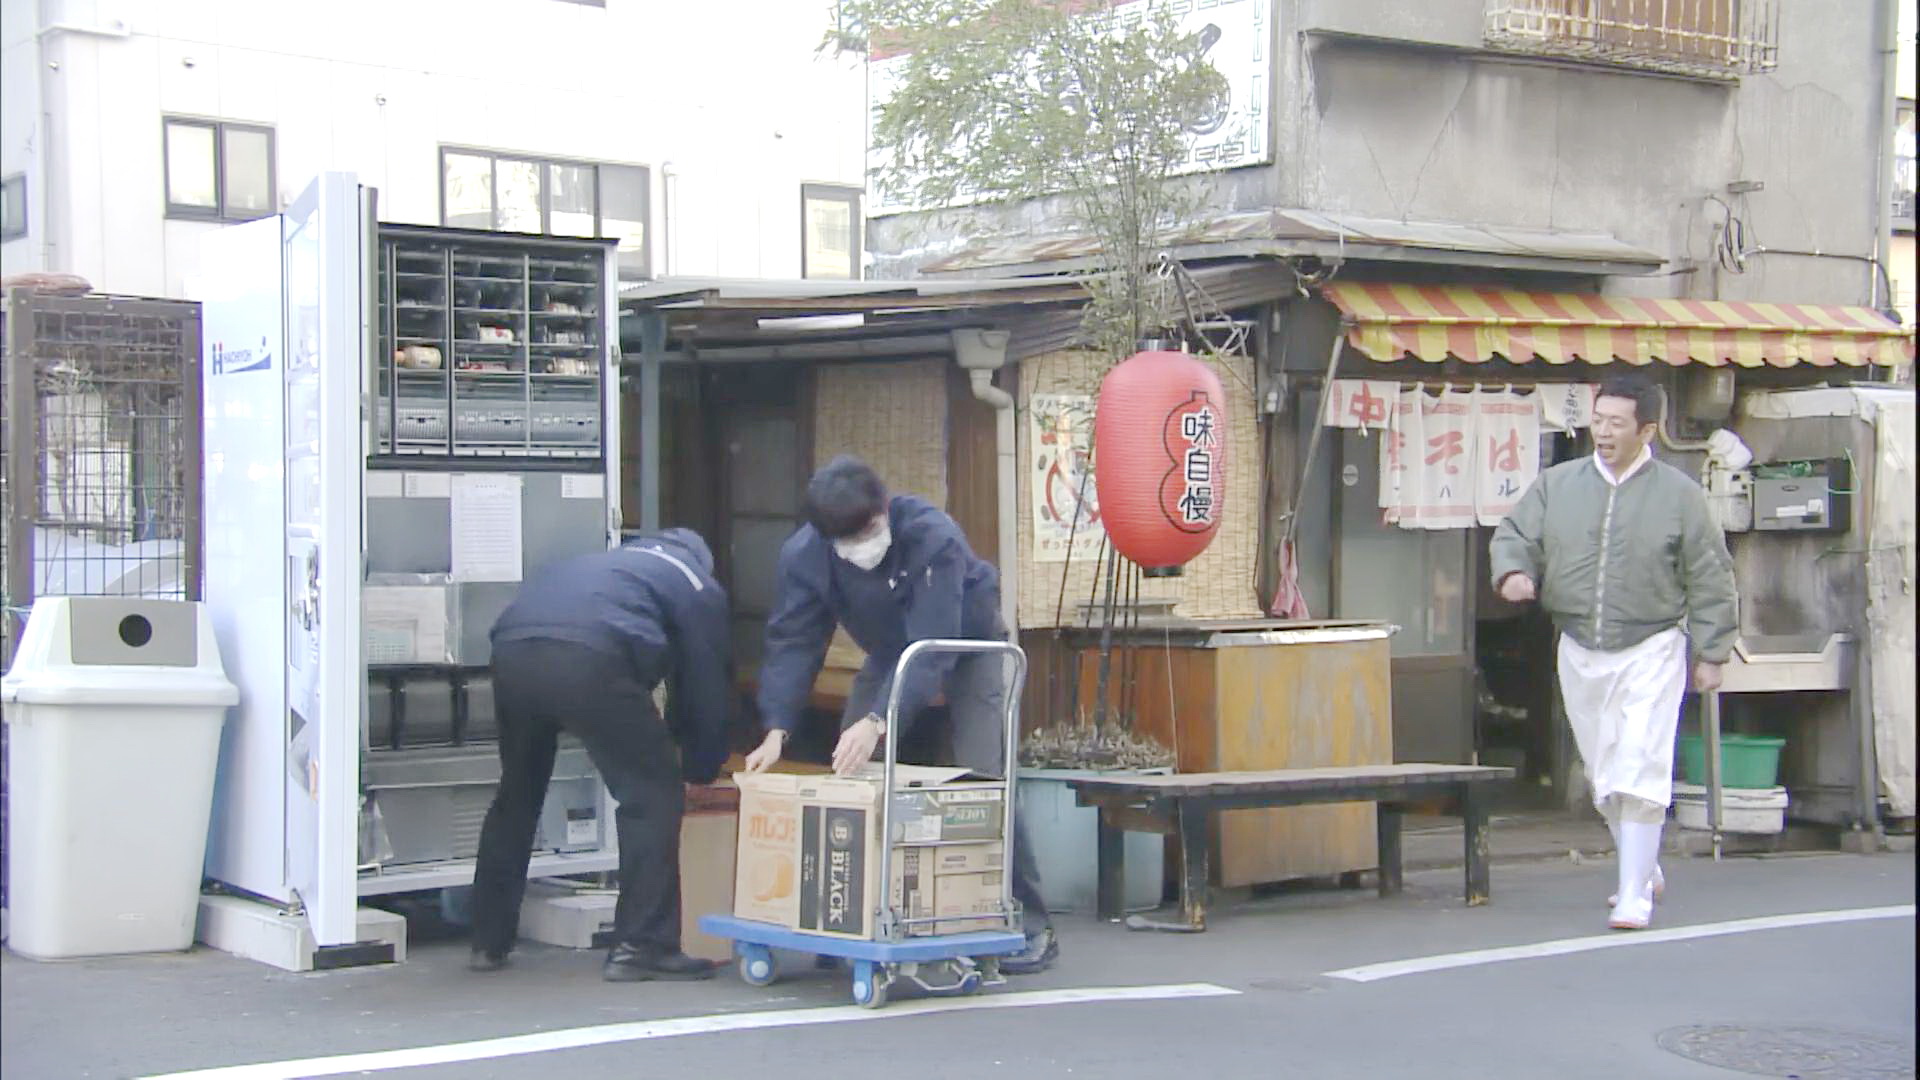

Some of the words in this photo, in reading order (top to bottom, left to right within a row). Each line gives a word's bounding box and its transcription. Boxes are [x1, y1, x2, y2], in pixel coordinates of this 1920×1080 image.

[1180, 408, 1216, 523] 味自慢
[829, 850, 845, 925] BLACK
